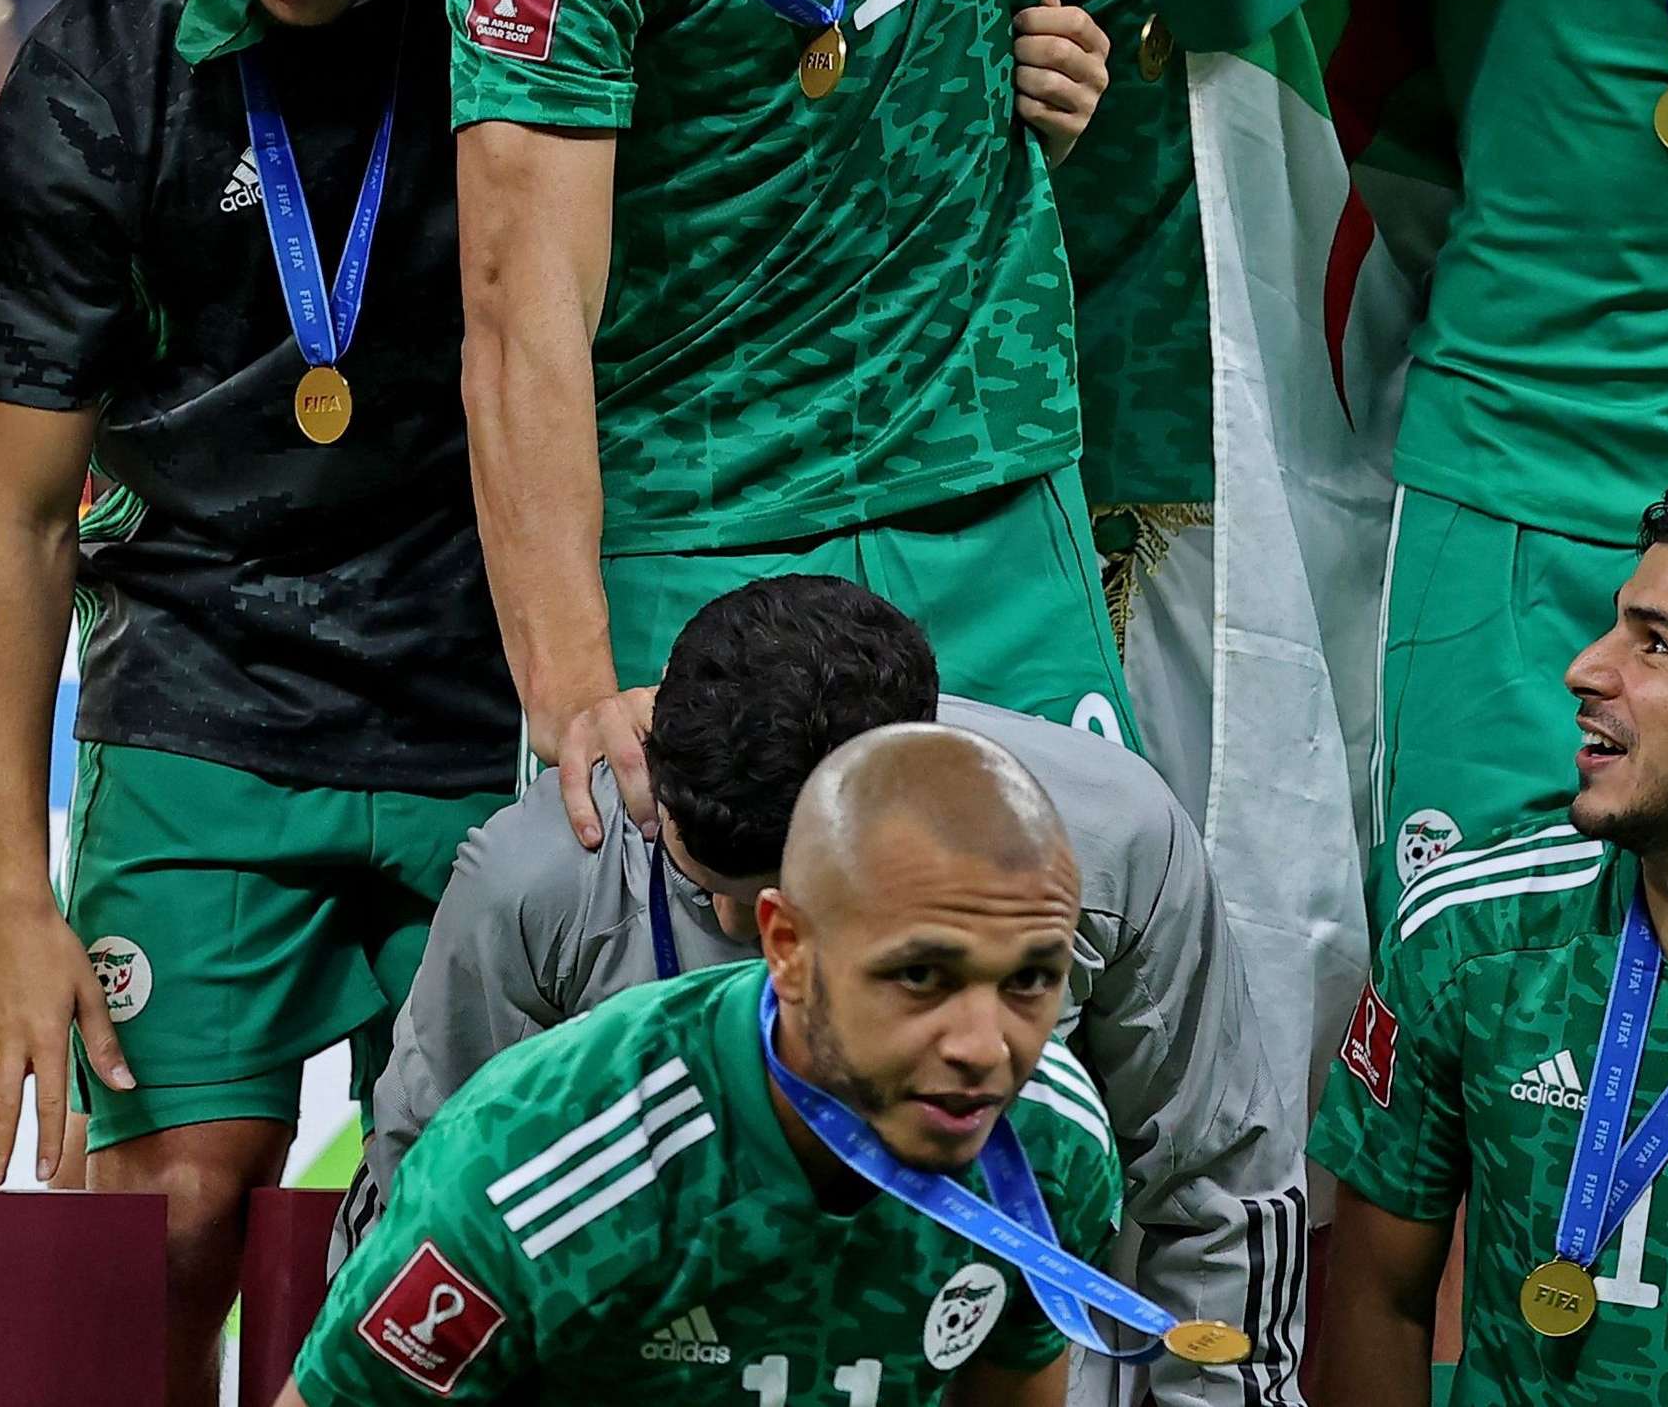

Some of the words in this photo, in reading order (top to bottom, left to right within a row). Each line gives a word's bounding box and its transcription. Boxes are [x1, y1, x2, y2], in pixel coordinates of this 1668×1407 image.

[476, 25, 504, 39] QATAR
[505, 31, 529, 43] 2021
[492, 19, 515, 30] ARAB
[517, 24, 534, 34] CUP
[806, 52, 834, 70] FIFA
[220, 184, 263, 212] adid
[276, 184, 293, 217] FIFA
[288, 237, 306, 271] FIFA
[300, 290, 316, 323] FIFA
[303, 395, 343, 414] FIFA
[1628, 958, 1644, 994] FIFA
[1617, 1012, 1633, 1048] FIFA
[1510, 1081, 1590, 1111] adidas
[1605, 1066, 1622, 1102] FIFA
[1593, 1120, 1610, 1155] FIFA
[1636, 1135, 1661, 1168] FIFA
[1581, 1174, 1597, 1209] FIFA
[1535, 1284, 1584, 1315] FIFA
[641, 1339, 731, 1364] adidas
